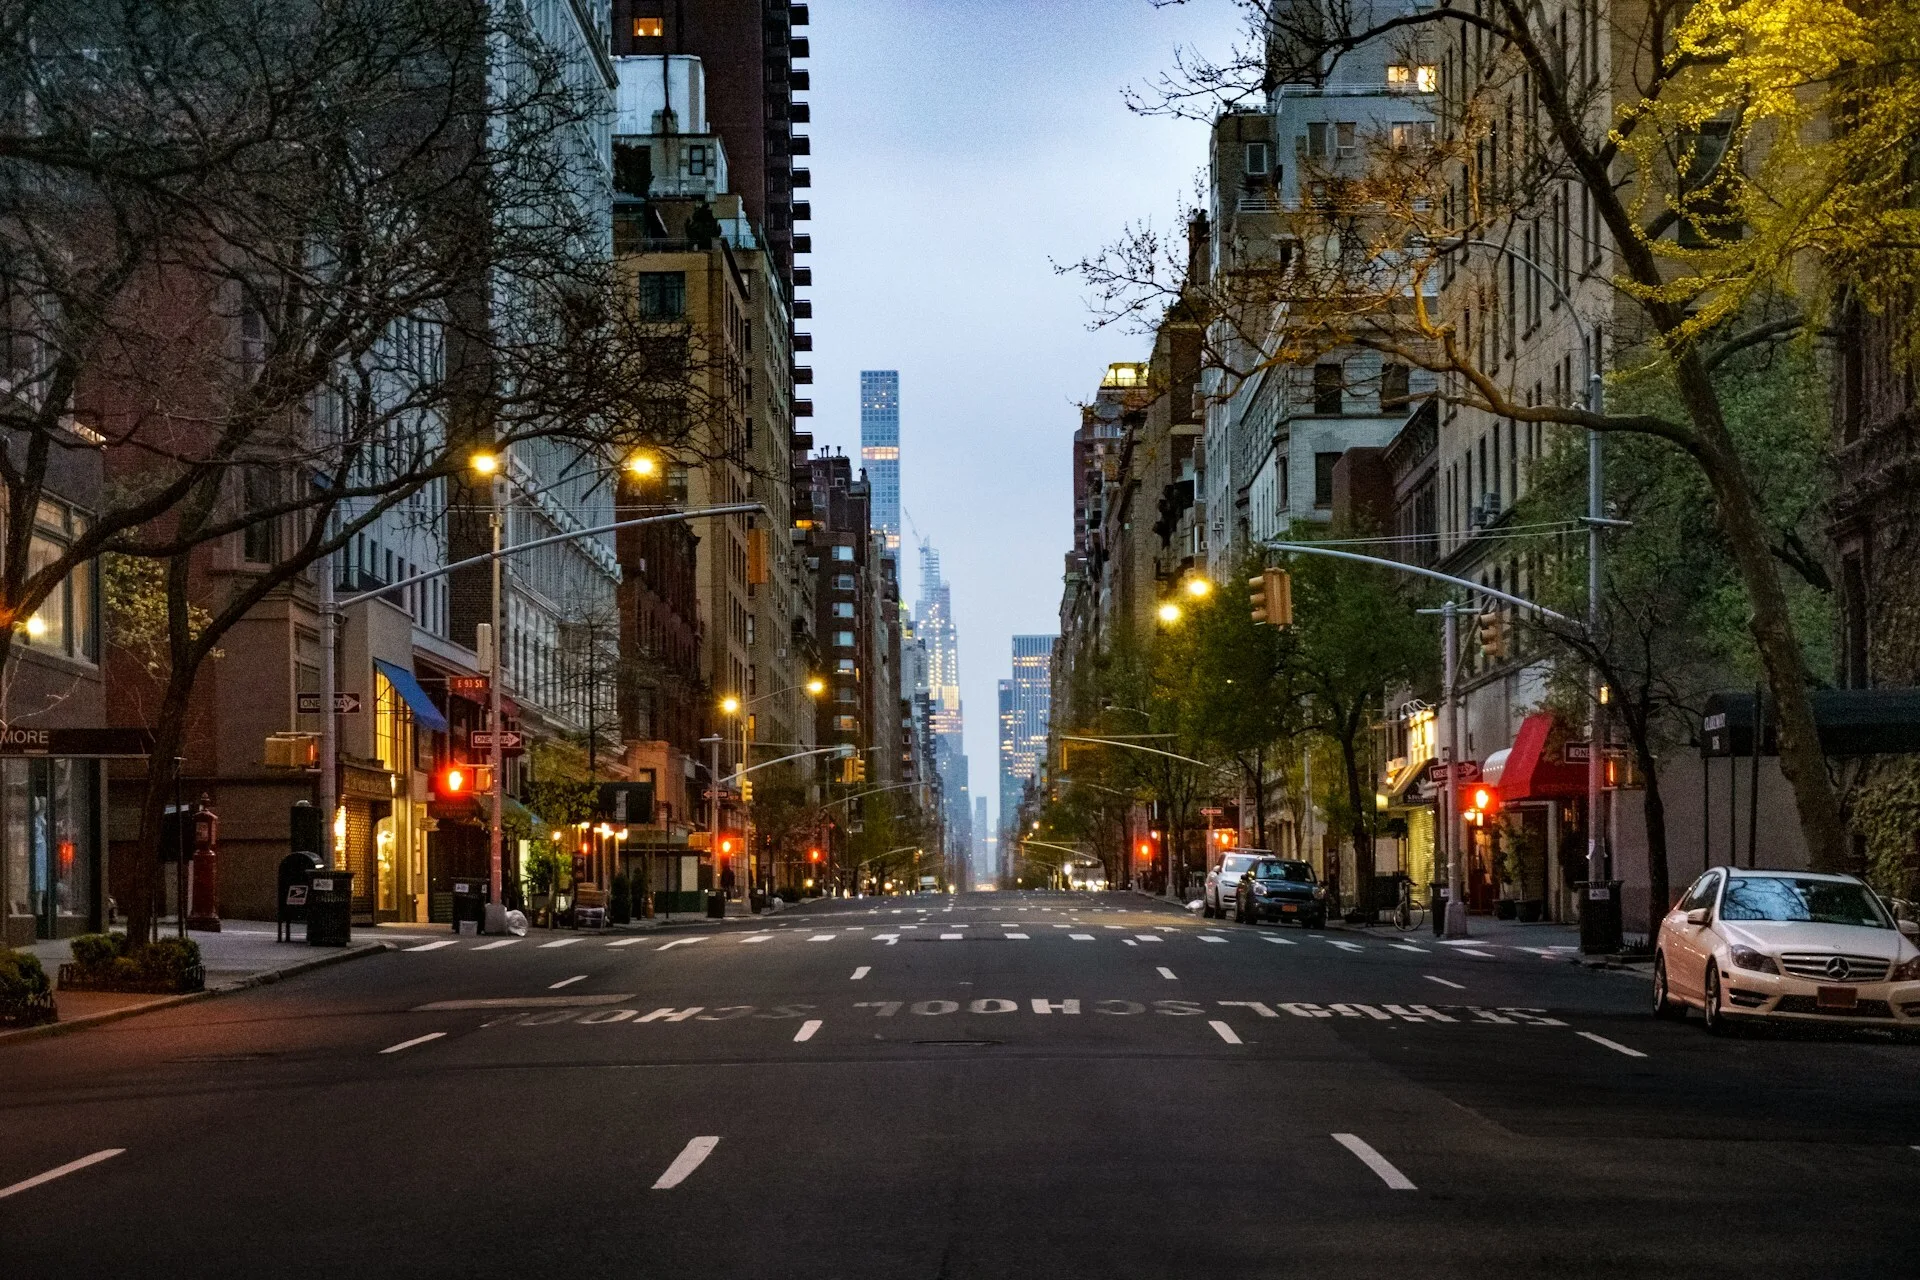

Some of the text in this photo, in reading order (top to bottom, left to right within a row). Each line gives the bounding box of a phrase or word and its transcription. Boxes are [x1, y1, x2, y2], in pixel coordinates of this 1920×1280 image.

[464, 679, 473, 688] 93
[302, 699, 320, 708] ONE
[852, 998, 1206, 1017] SCHOOL
